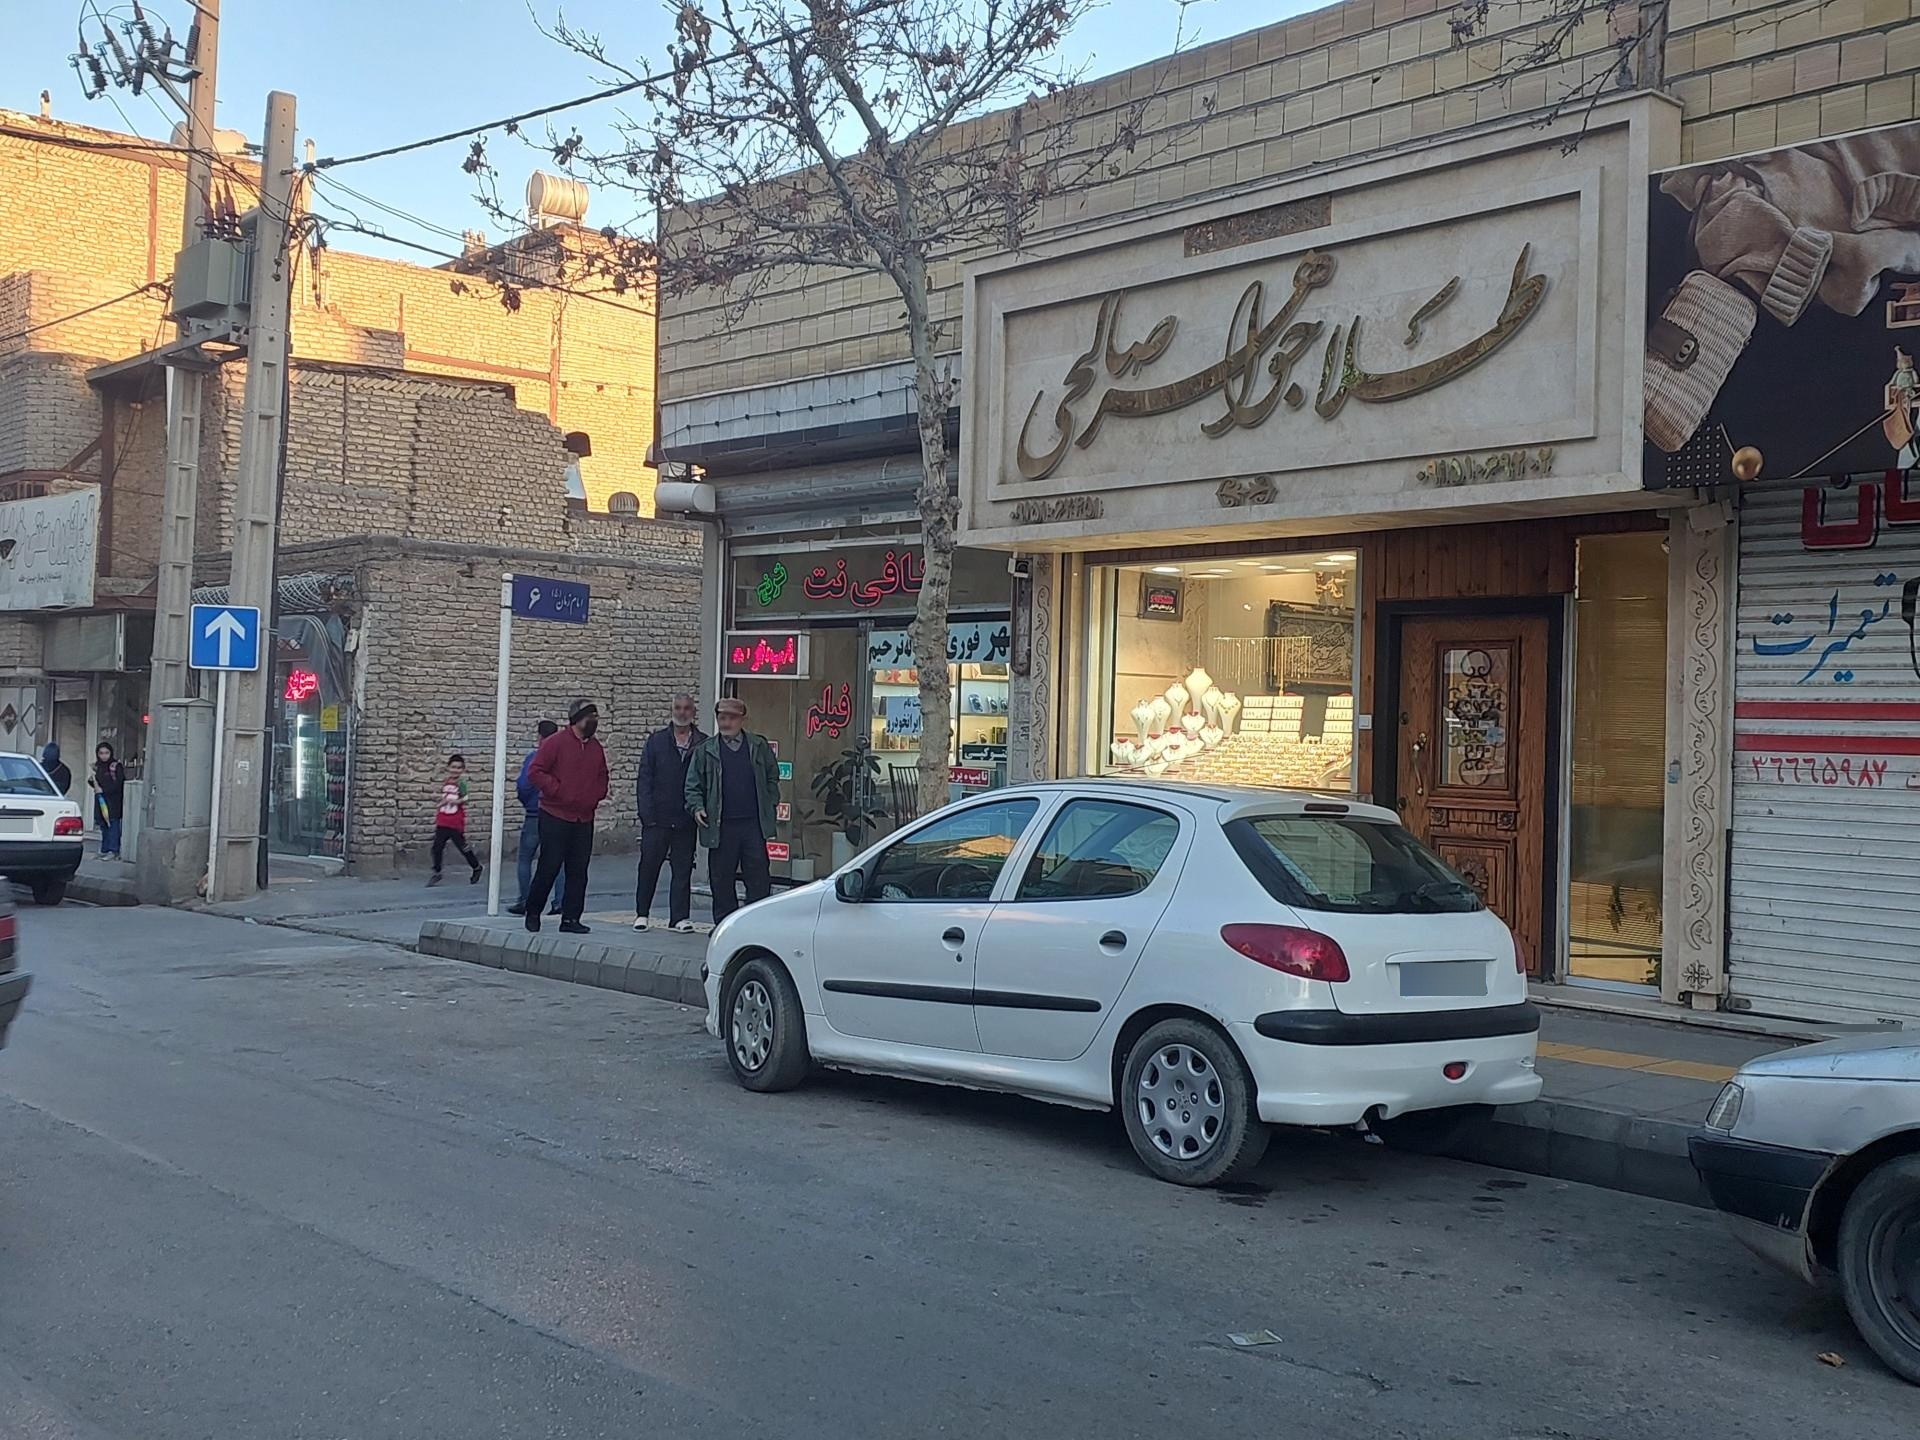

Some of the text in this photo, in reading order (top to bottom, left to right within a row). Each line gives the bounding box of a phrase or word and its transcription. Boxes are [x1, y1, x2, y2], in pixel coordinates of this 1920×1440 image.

[528, 587, 541, 610] ۶
[803, 559, 849, 600] نت
[1752, 572, 1897, 685] تعمیرات
[807, 682, 852, 739] فیلم
